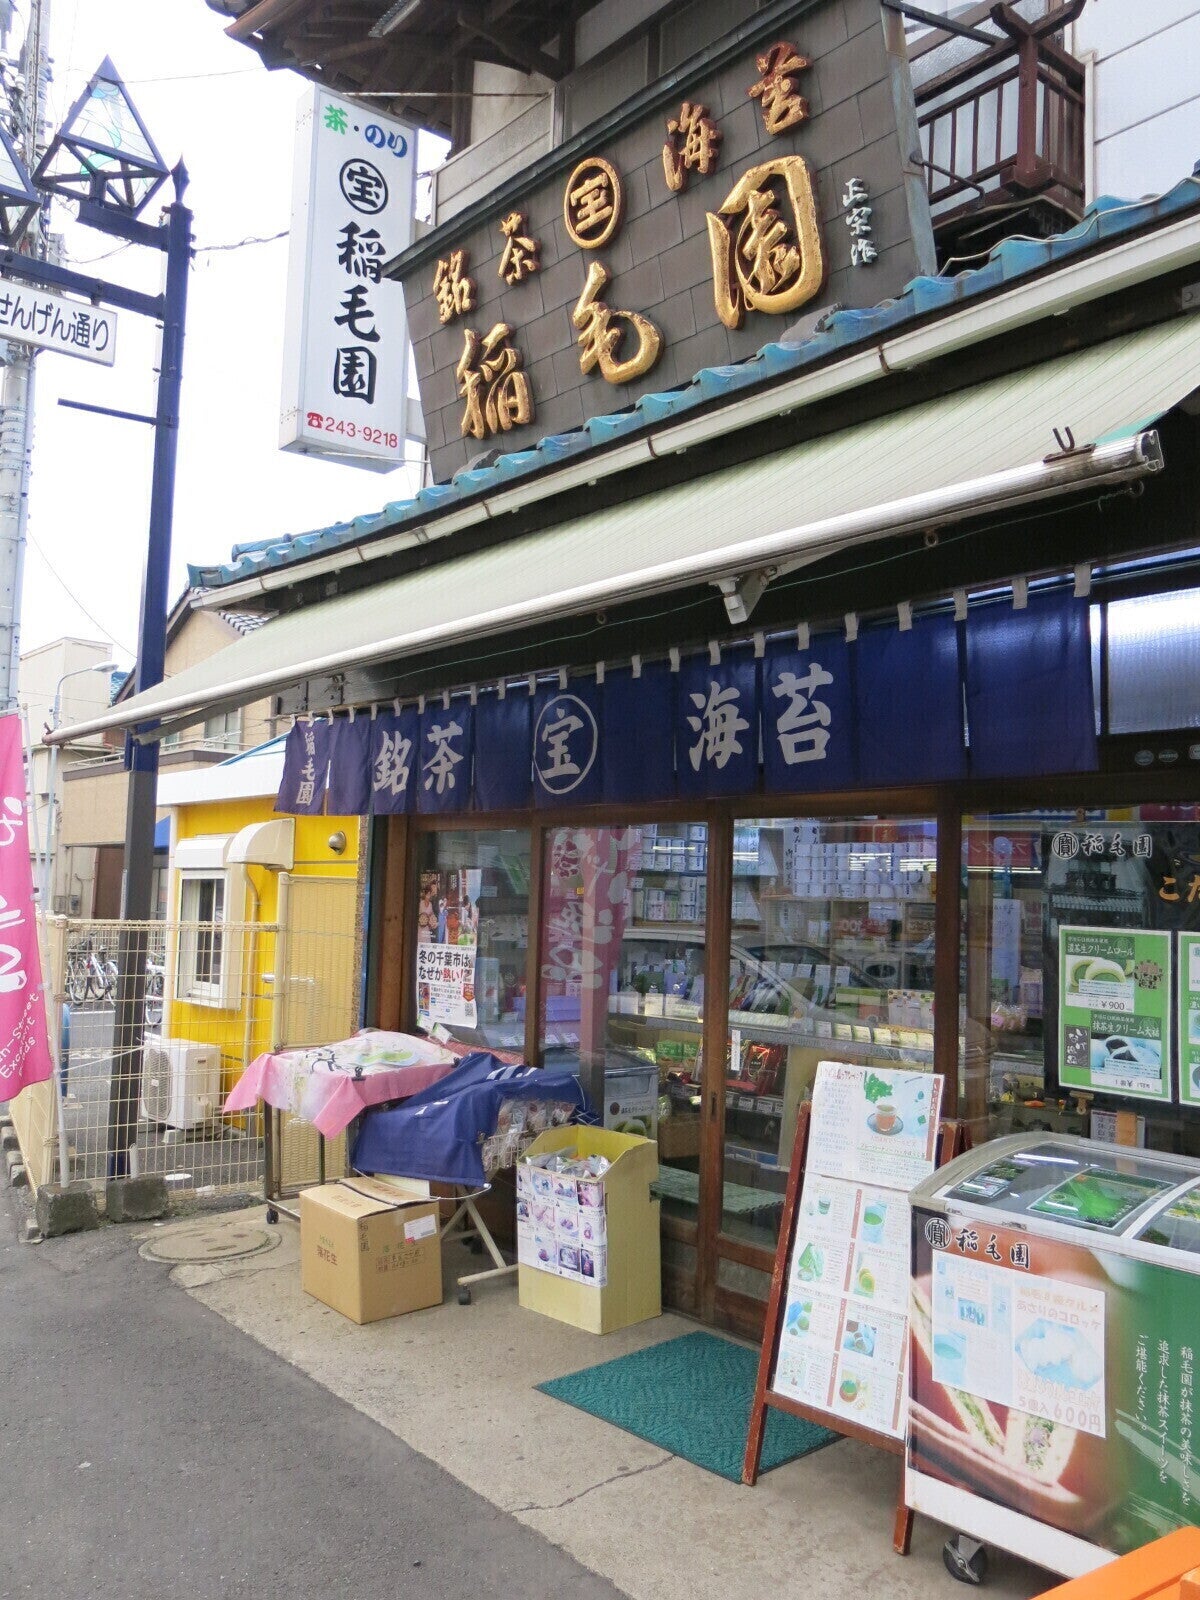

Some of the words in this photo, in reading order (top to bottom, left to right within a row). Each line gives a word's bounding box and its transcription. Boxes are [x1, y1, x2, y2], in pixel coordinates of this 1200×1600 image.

[332, 220, 387, 405] 稲毛園
[324, 416, 398, 449] 243-9218
